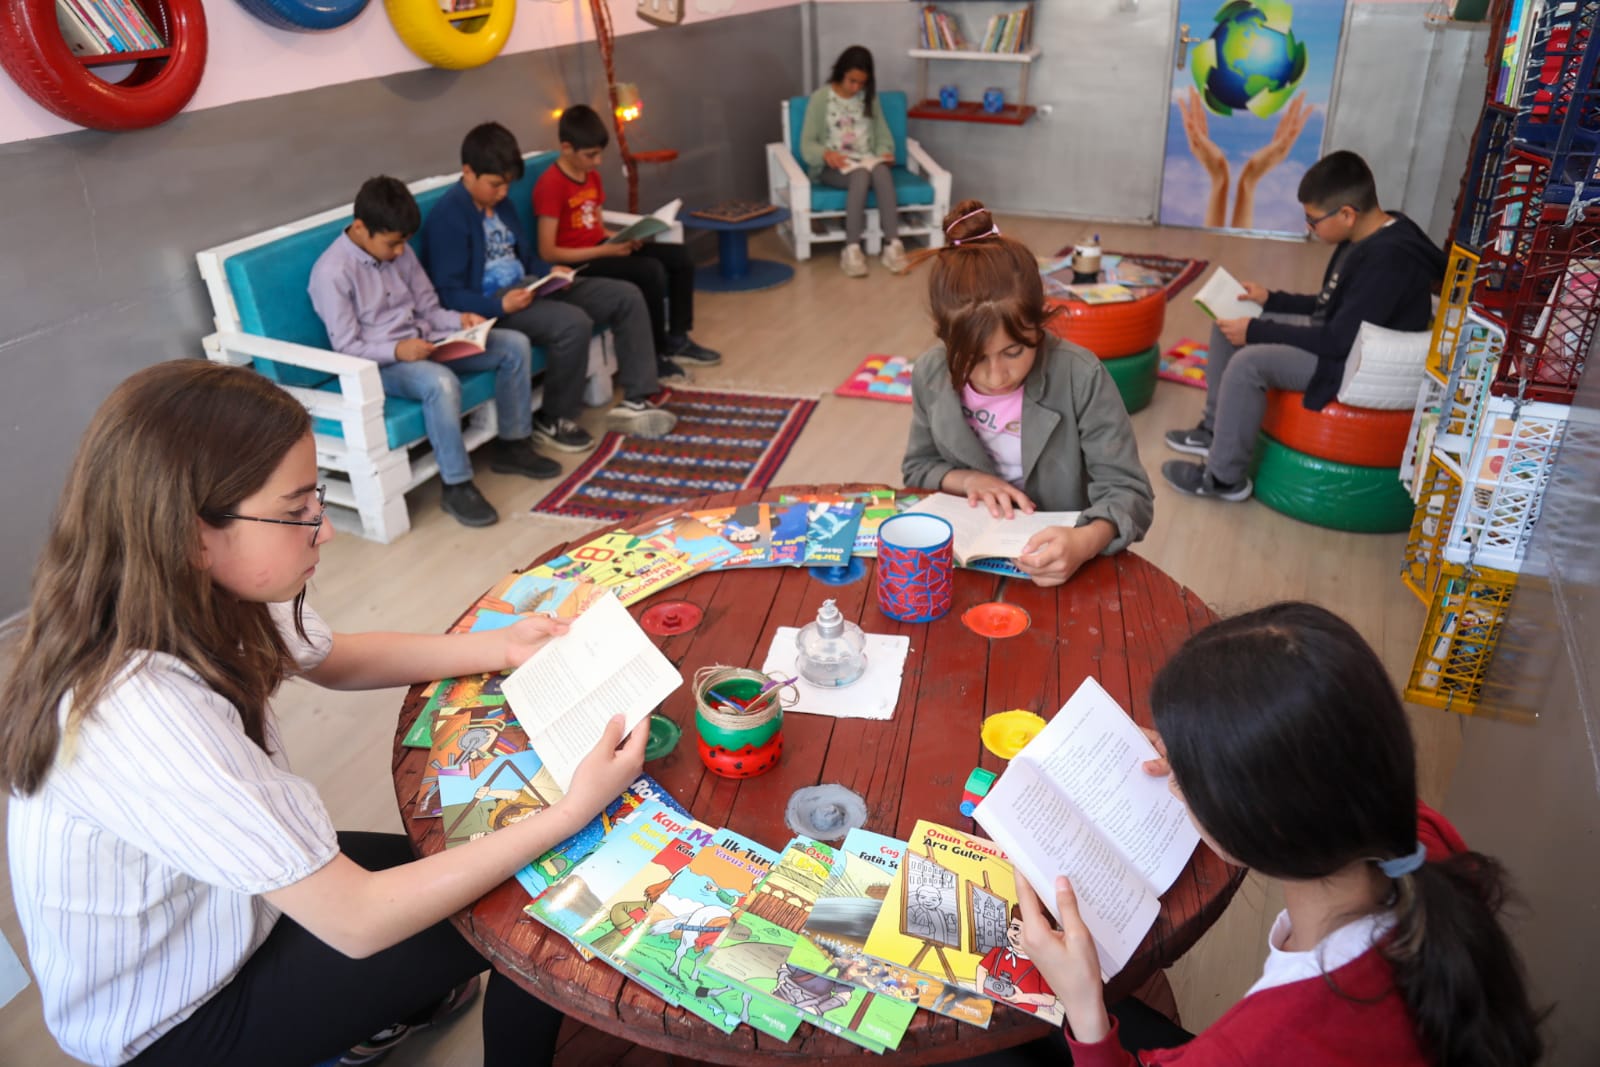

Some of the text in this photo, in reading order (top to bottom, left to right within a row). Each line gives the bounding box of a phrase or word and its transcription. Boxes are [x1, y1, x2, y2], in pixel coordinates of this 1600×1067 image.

[927, 828, 961, 845] Onun
[923, 838, 948, 851] Ara
[859, 851, 886, 866] Fatih
